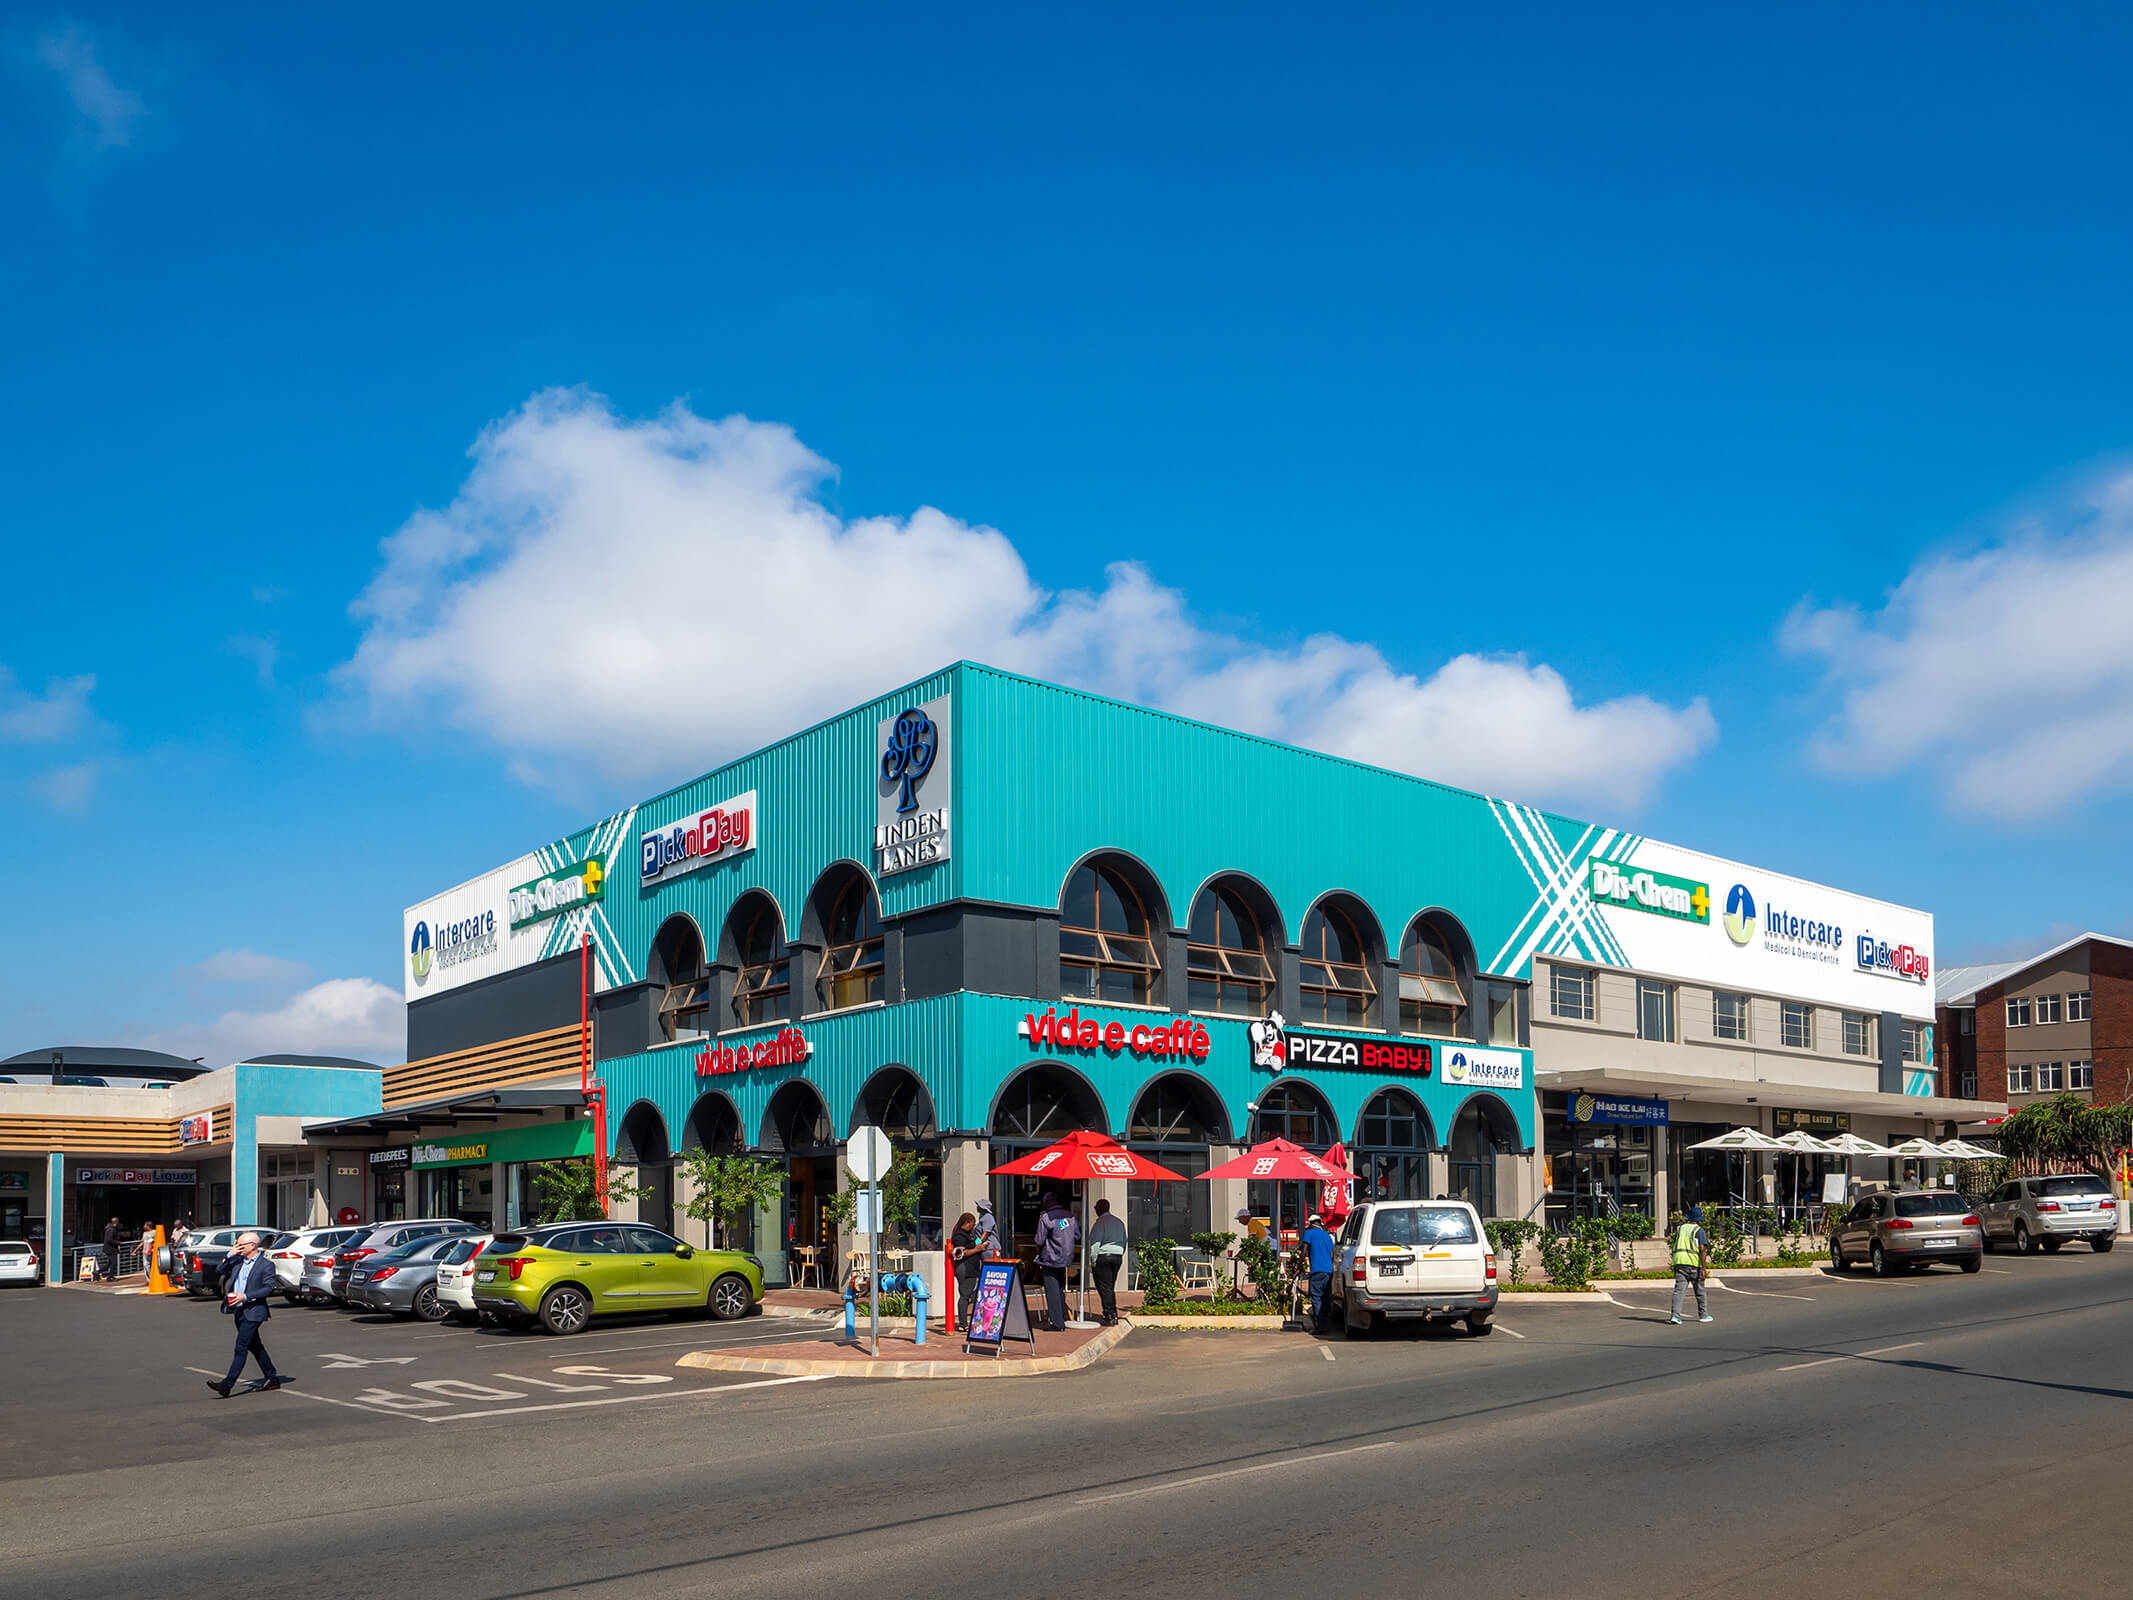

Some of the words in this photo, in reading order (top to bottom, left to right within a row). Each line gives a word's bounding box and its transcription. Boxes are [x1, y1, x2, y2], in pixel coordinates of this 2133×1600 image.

[641, 828, 687, 879] Pick
[699, 807, 749, 858] Pay
[874, 807, 948, 850] LINDEN
[879, 836, 942, 873] LANES
[507, 875, 583, 924] Dis-Chem
[1592, 861, 1691, 914] Dis-Chem
[435, 909, 495, 951] Intercare
[1766, 902, 1842, 947] Intercare
[1764, 940, 1790, 955] Medical
[1819, 951, 1839, 965] Centre
[1856, 934, 1893, 968] Pick
[1899, 944, 1928, 979] Pay
[695, 1040, 736, 1076] vida
[737, 1045, 750, 1070] e
[753, 1028, 807, 1068] caffè
[1025, 1007, 1099, 1048] vida
[1104, 1021, 1125, 1050] e
[1131, 1019, 1211, 1057] caffè
[1290, 1037, 1358, 1065] PIZZA
[1362, 1043, 1431, 1072] BABY!
[1471, 1060, 1520, 1077] Intercare
[412, 1144, 446, 1163] Dis-Chem
[448, 1144, 488, 1160] PHARMACY
[1092, 1155, 1130, 1166] vida
[80, 1170, 112, 1182] Pick
[123, 1169, 152, 1182] Pay
[151, 1169, 196, 1183] Liquor
[353, 1365, 674, 1409] STOP
